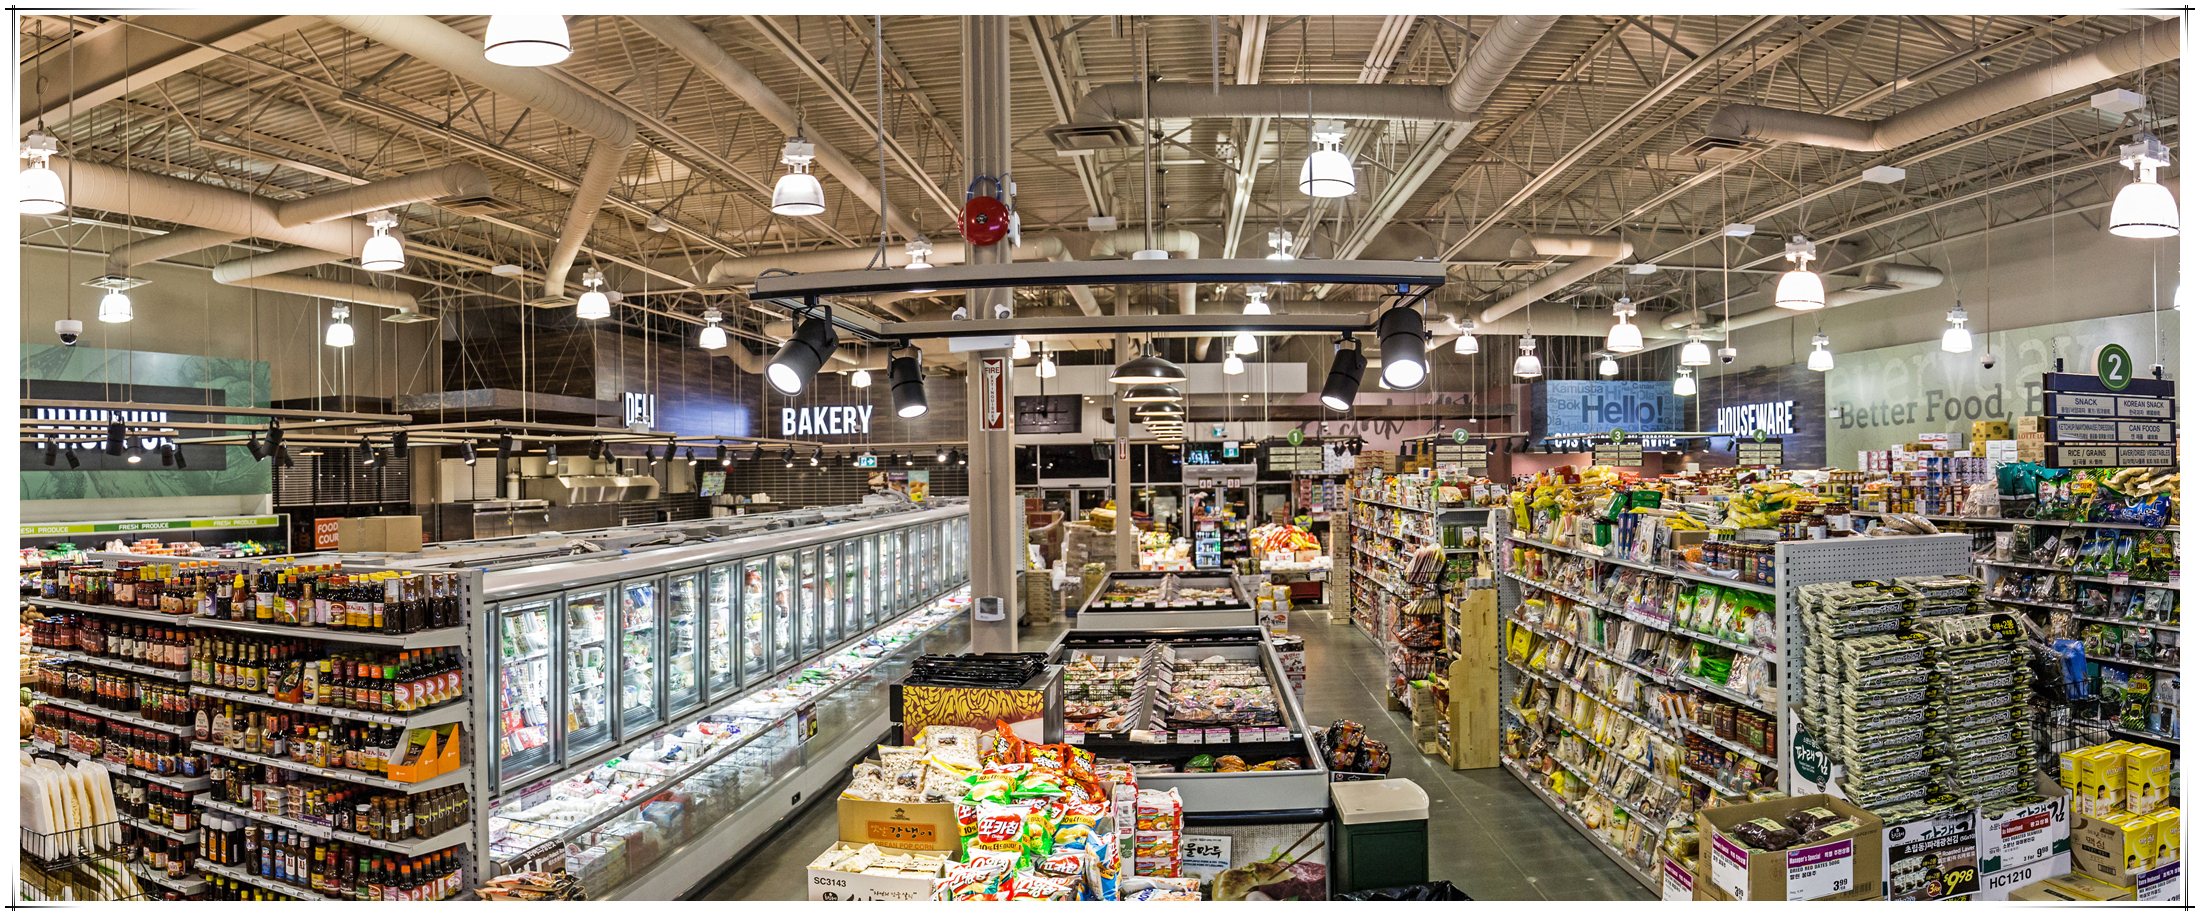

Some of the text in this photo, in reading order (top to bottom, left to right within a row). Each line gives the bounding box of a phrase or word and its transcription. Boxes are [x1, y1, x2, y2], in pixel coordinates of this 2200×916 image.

[984, 366, 1000, 374] FIRE
[2108, 354, 2124, 380] 2
[1552, 382, 1604, 394] Kamusta
[1605, 385, 1622, 400] Hi
[1558, 400, 1580, 410] Bok
[1840, 382, 2044, 430] Better Food, B
[2074, 398, 2098, 406] SNACK
[2124, 400, 2145, 408] KOREAN
[624, 392, 654, 428] DELI
[1582, 395, 1664, 424] Hello!
[782, 405, 873, 436] BAKERY
[1717, 400, 1794, 436] HOUSEWARE
[1293, 432, 1298, 442] 1
[1458, 432, 1465, 441] 2
[1614, 431, 1620, 440] 3
[1757, 432, 1762, 440] 4
[2018, 432, 2036, 440] LOTTE
[317, 523, 338, 534] FOOD
[318, 534, 339, 545] COUR
[2106, 766, 2124, 776] Maxim
[2152, 764, 2168, 774] Maxim
[889, 826, 932, 839] 강냉이
[980, 820, 1020, 836] 포카칩
[2086, 836, 2105, 850] 맥심
[813, 876, 847, 888] SC3143
[1989, 868, 2032, 889] HC1210
